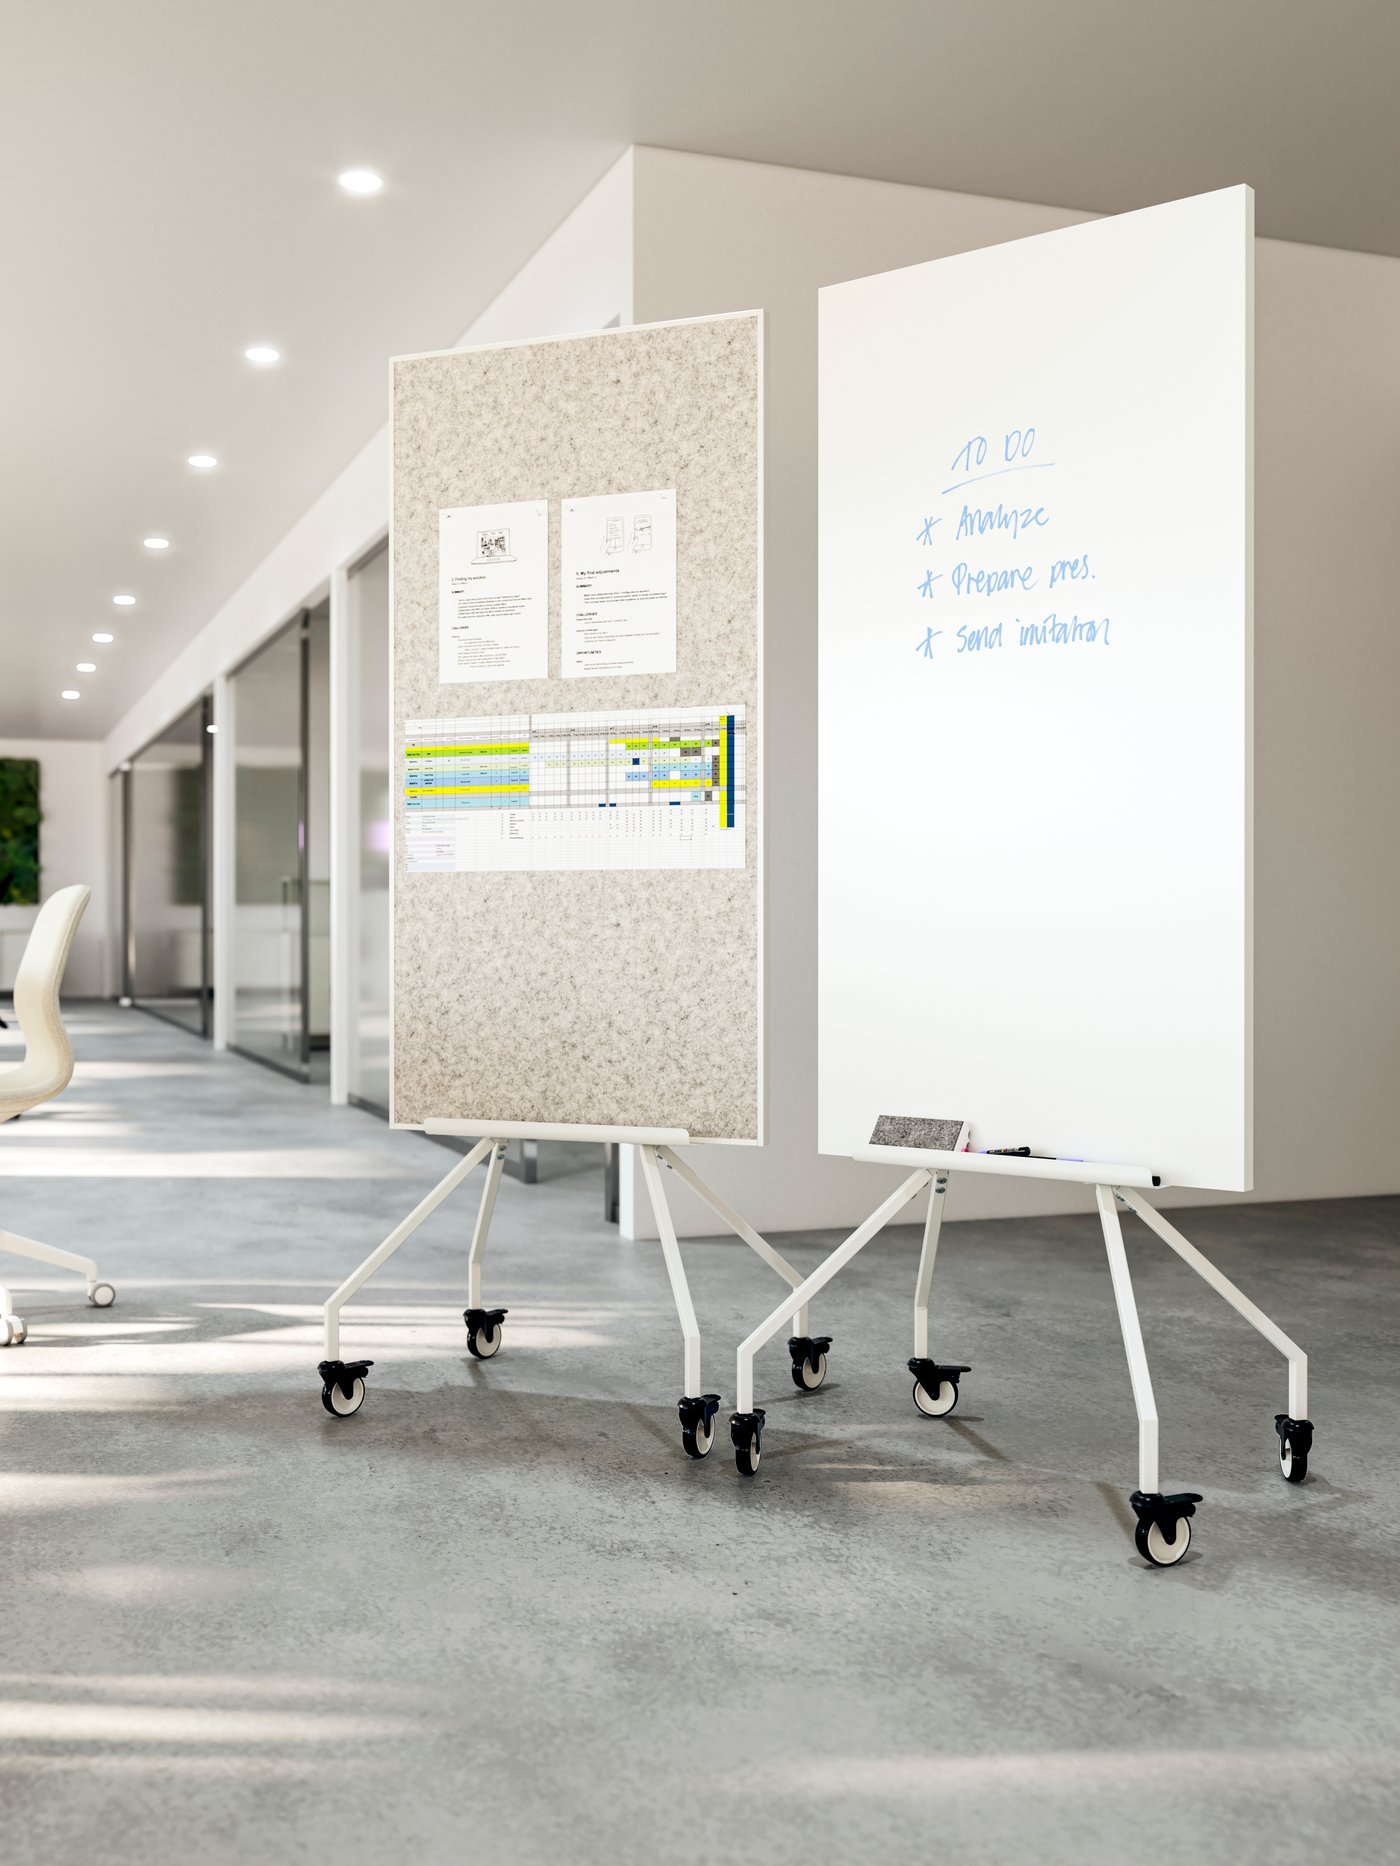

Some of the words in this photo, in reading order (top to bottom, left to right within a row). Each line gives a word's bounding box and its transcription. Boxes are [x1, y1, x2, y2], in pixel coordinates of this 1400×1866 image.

[951, 435, 988, 471] TO
[1005, 428, 1035, 462] DO
[956, 504, 1050, 540] Analyze
[952, 562, 1039, 597] Prepare
